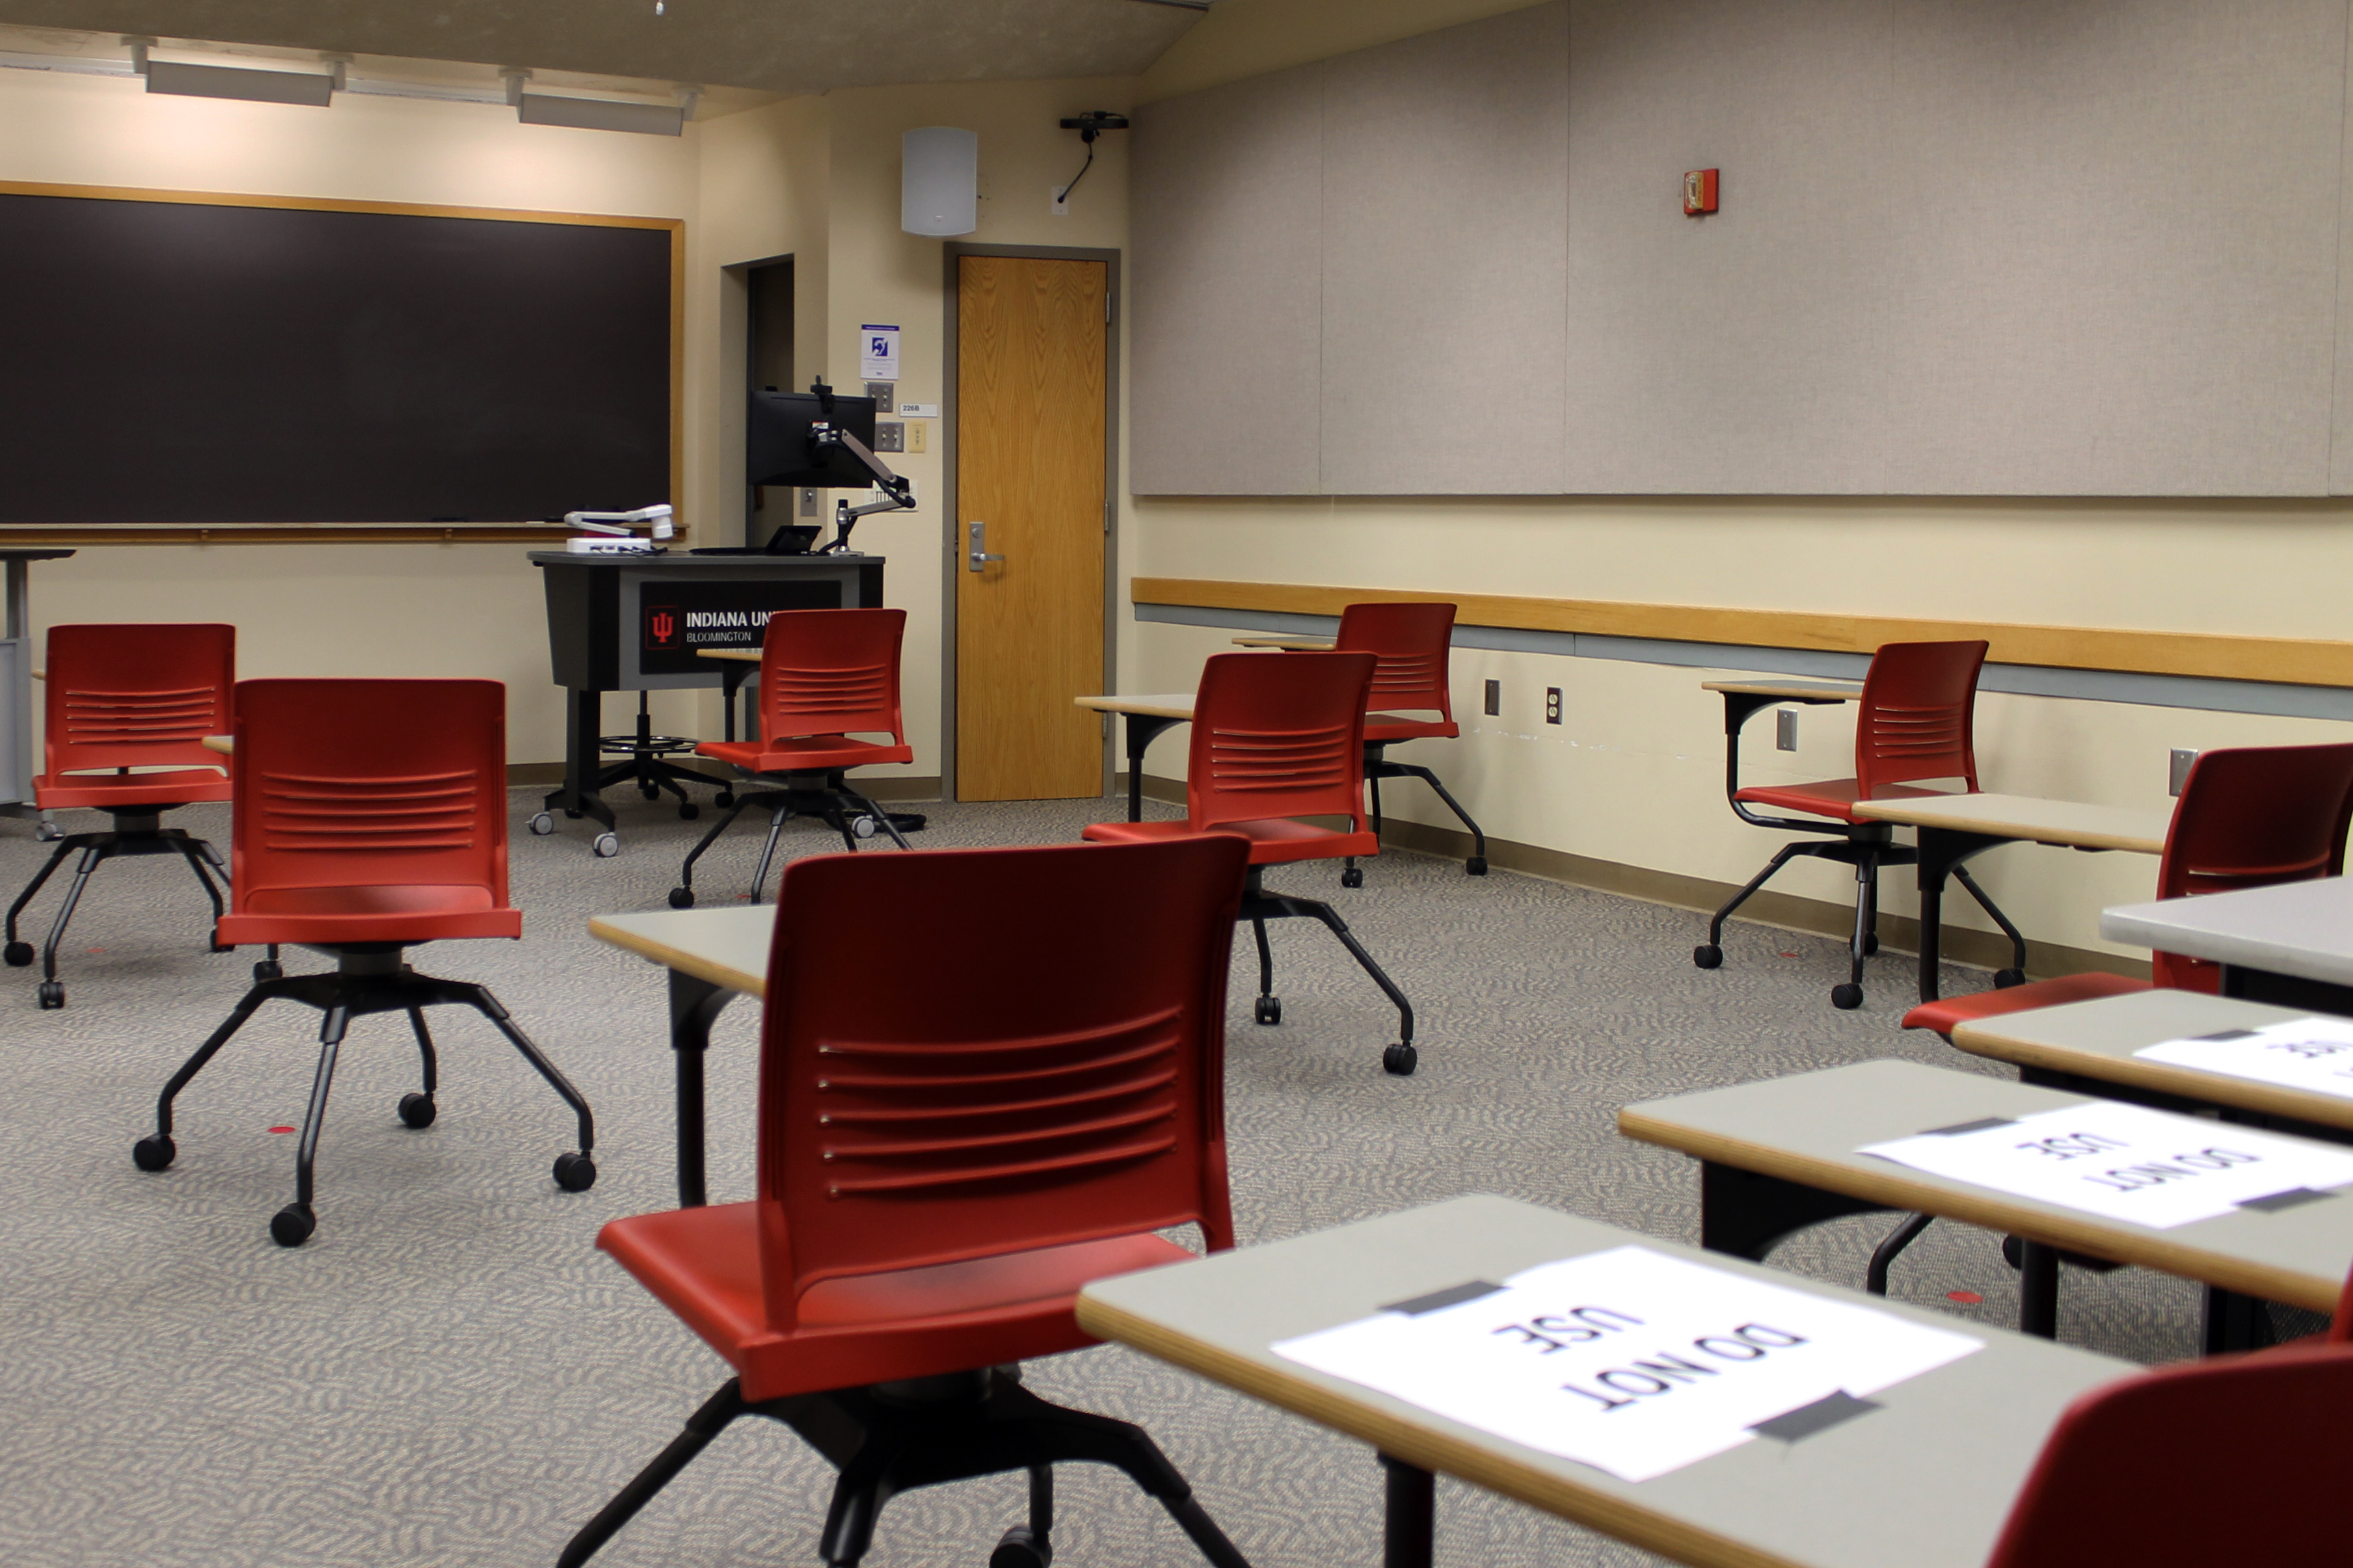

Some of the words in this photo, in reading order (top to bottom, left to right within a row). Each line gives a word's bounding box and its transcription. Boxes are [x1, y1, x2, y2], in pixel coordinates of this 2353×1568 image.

[686, 611, 747, 628] INDIANA
[686, 631, 751, 643] BLOOMINGTON
[2015, 1132, 2131, 1160] USE
[2171, 1147, 2263, 1170] DO
[2082, 1162, 2201, 1192] NOT
[1490, 1307, 1646, 1355] USE
[1693, 1323, 1810, 1361] DO
[1559, 1352, 1721, 1412] NOT
